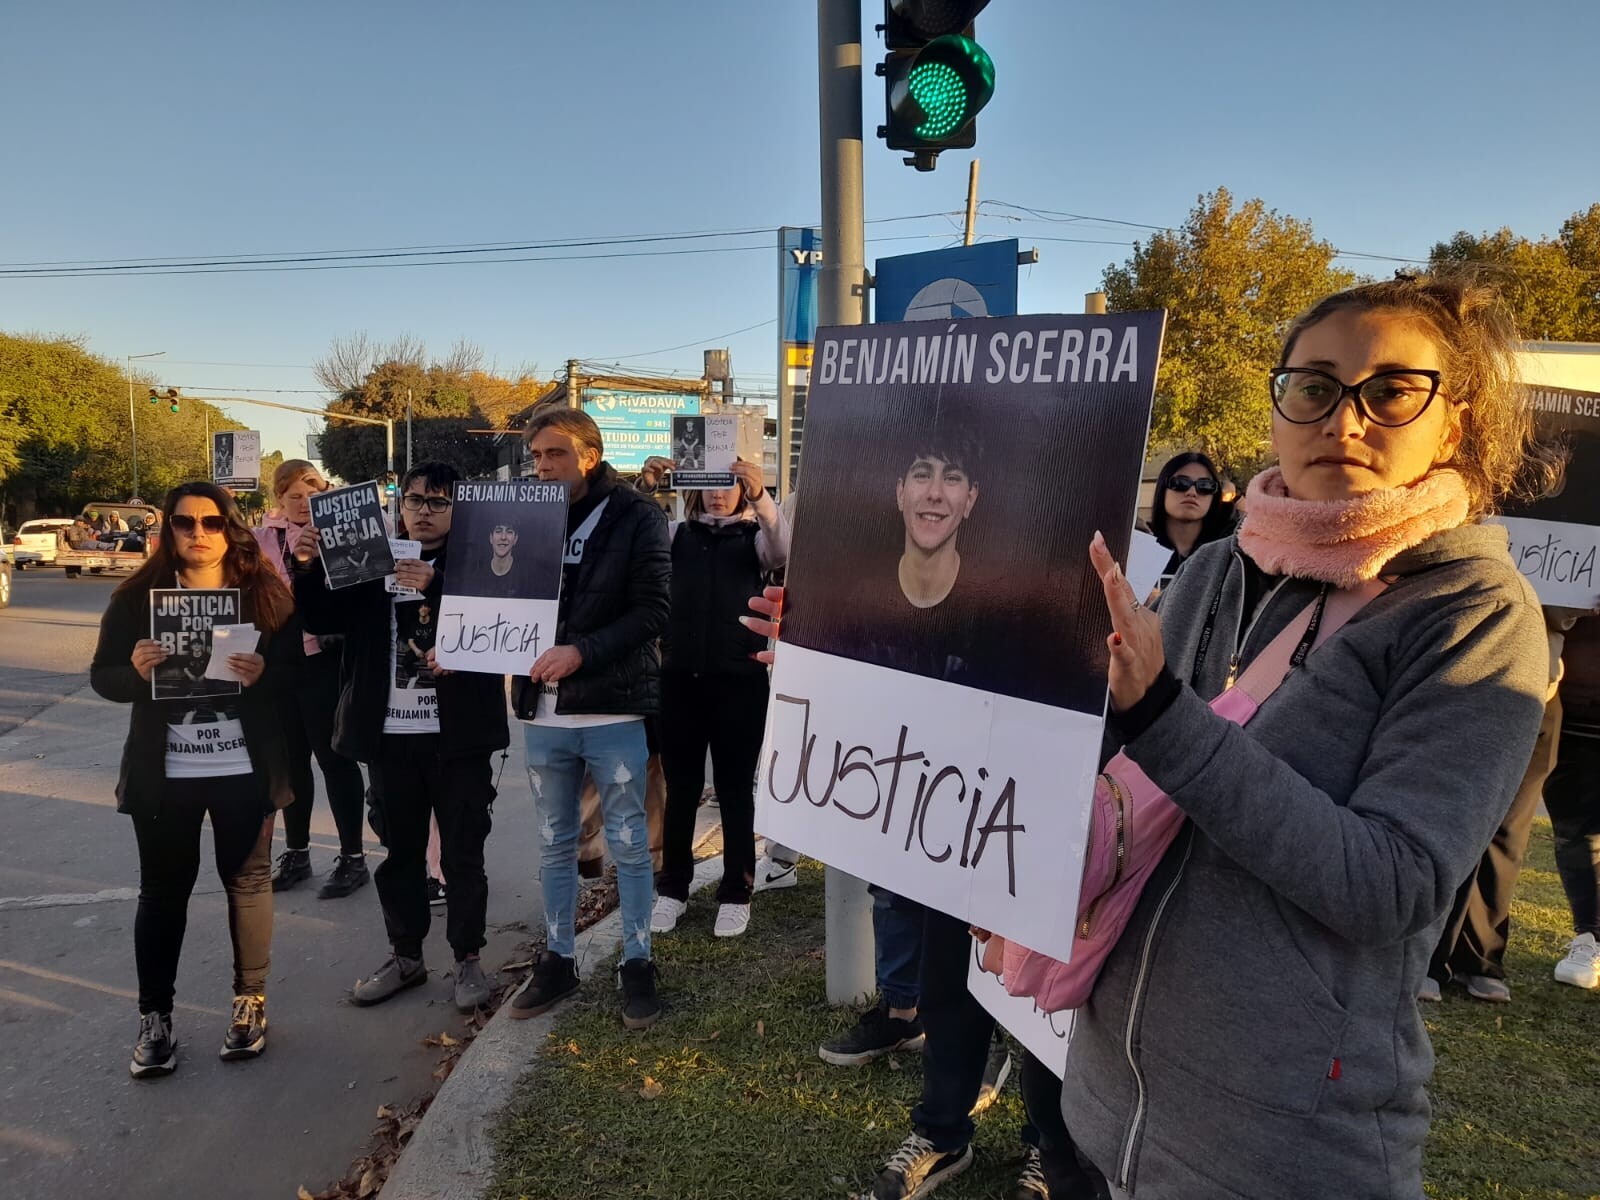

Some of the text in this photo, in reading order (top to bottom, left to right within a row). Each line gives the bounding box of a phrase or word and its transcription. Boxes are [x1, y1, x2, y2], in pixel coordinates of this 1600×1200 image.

[792, 249, 823, 265] YP
[819, 323, 1138, 385] BENJAMÍN SCERRA
[619, 395, 686, 409] RIVADAVIA
[602, 431, 640, 443] STUDIO
[519, 484, 565, 503] SCERRA
[314, 487, 376, 518] JUSTICIA
[335, 507, 361, 525] POR
[320, 516, 382, 550] BENJA
[157, 595, 235, 617] JUSTICIA
[181, 616, 213, 631] POR
[160, 631, 212, 656] BEN
[417, 695, 437, 705] POR
[433, 708, 440, 719] S
[197, 728, 221, 740] POR
[165, 737, 247, 754] ENJAMIN SCER
